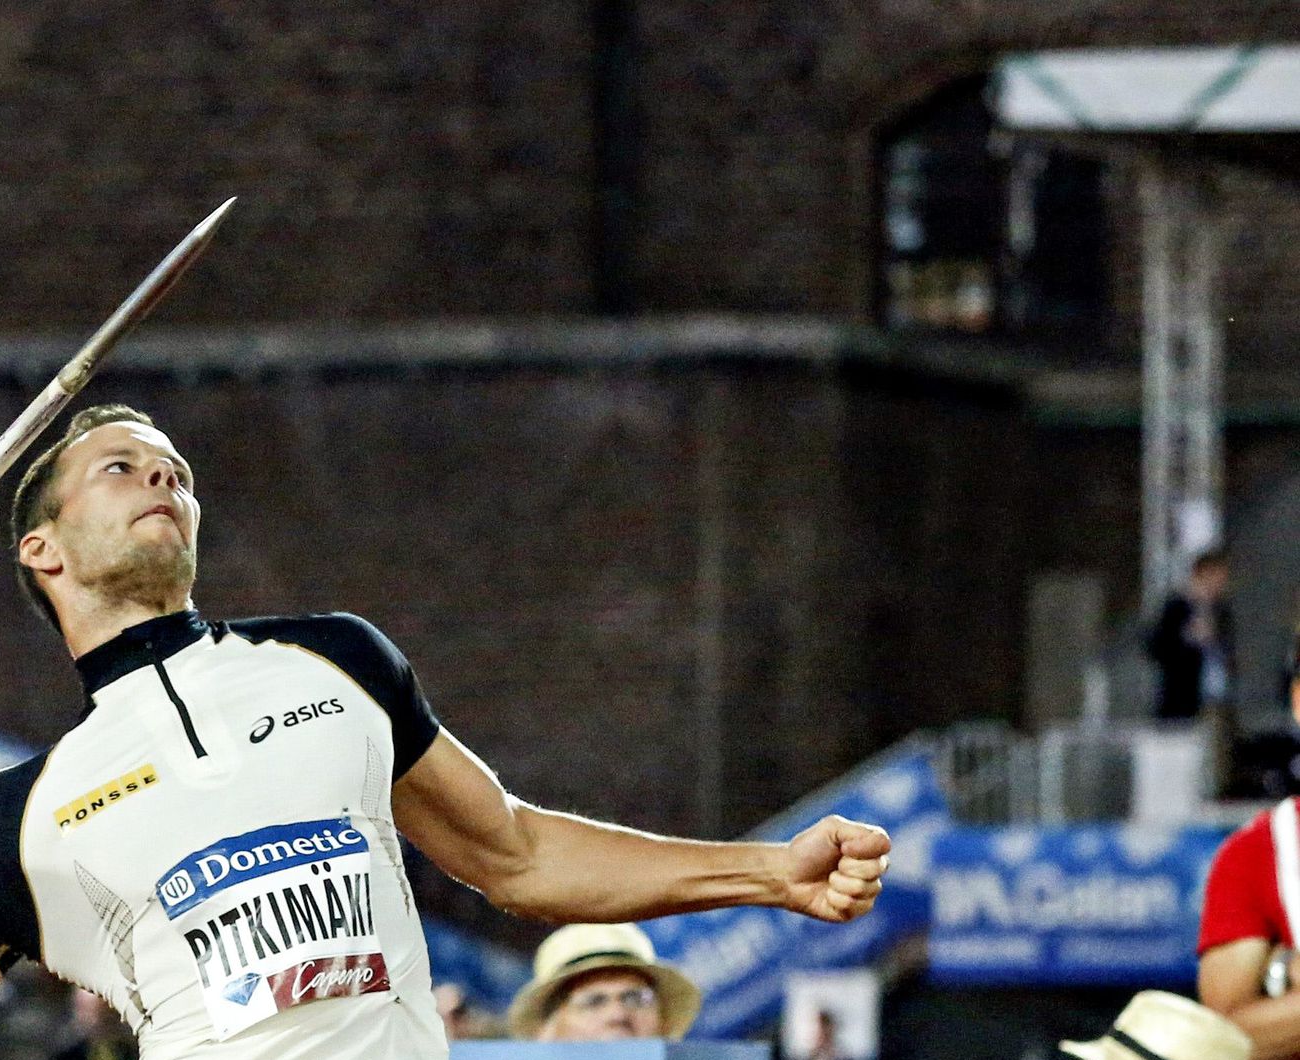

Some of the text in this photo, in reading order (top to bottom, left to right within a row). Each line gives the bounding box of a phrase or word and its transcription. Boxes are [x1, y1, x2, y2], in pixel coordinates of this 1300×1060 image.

[283, 698, 345, 728] asics
[196, 828, 363, 888] Dometic
[183, 860, 376, 990] PITKIMÄKI
